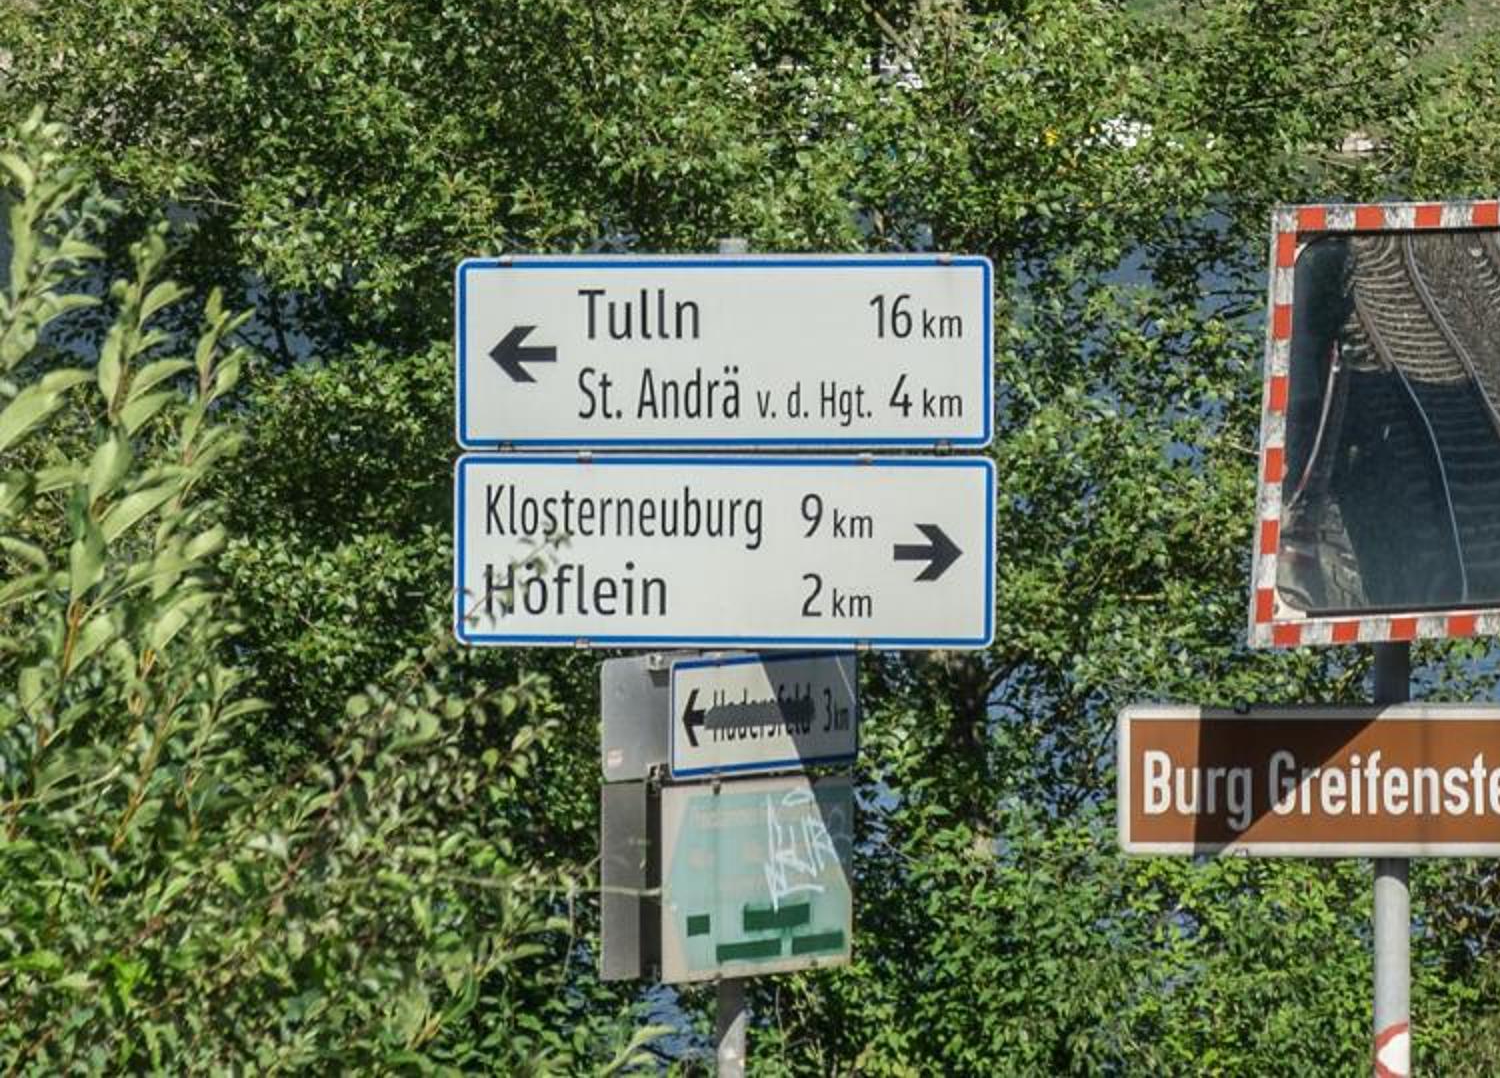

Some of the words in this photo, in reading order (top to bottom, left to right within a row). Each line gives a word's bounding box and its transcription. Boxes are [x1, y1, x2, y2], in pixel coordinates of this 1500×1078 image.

[578, 289, 700, 339] Tulln
[869, 294, 913, 339] 16
[922, 308, 963, 338] km
[578, 367, 622, 419] St.
[637, 366, 741, 419] Andrä
[757, 390, 776, 418] v.
[787, 383, 809, 418] d.
[820, 382, 873, 426] Hgt.
[889, 375, 913, 418] 4
[923, 388, 963, 418] km
[486, 485, 763, 549] Klosterneuburg
[801, 494, 824, 538] 9
[833, 508, 873, 538] km
[485, 563, 667, 616] Höflein
[802, 573, 824, 617] 2
[832, 588, 873, 617] km
[823, 688, 833, 733] 3
[1143, 750, 1252, 830] Burg
